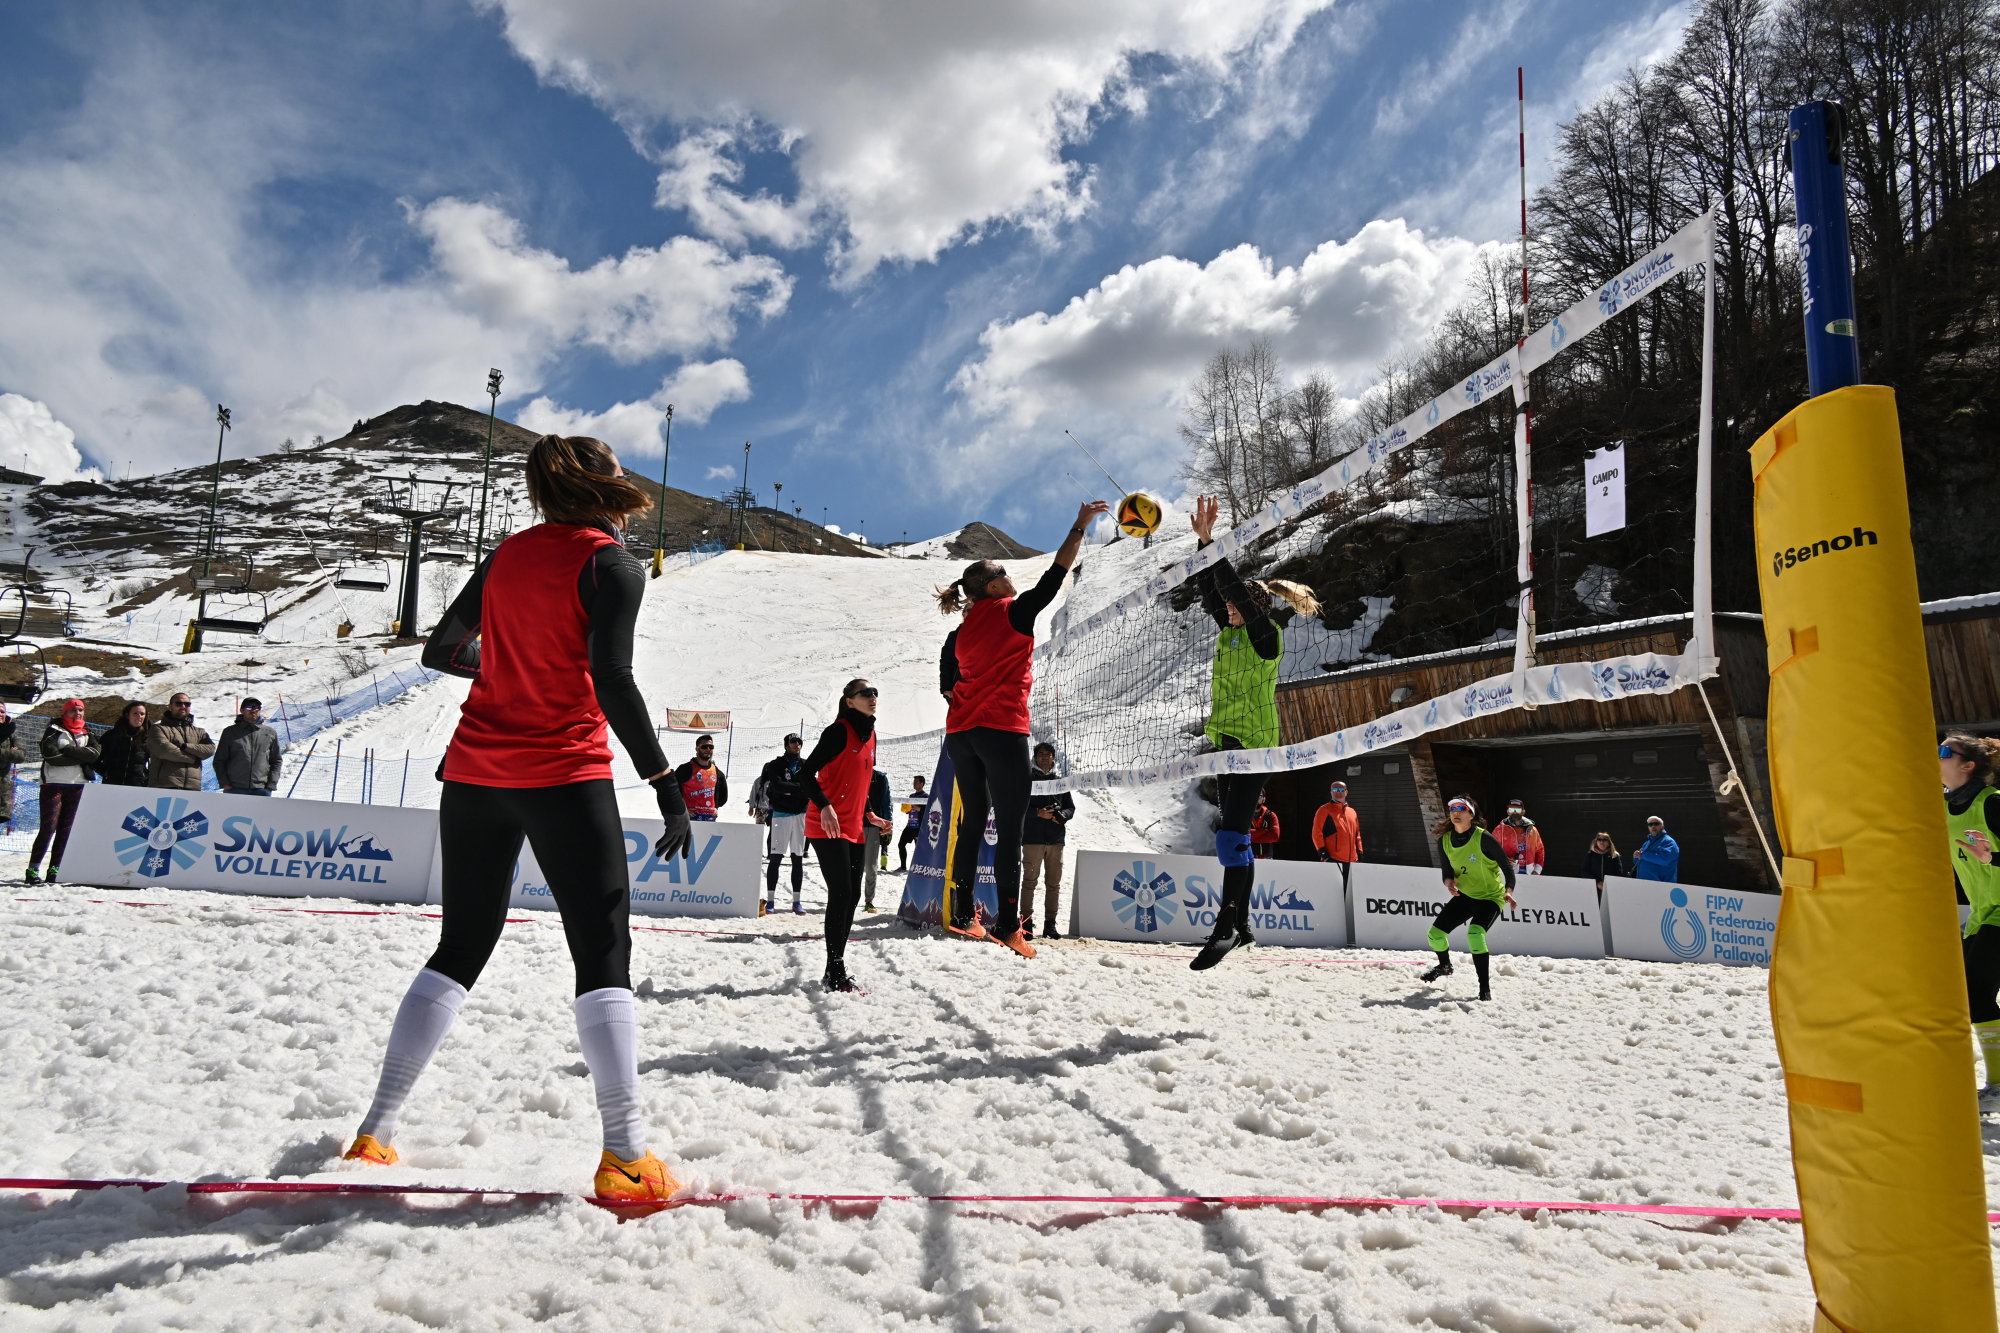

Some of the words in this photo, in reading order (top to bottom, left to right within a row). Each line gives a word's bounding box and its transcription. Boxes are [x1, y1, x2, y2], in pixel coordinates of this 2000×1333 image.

[1622, 253, 1660, 291] SNOW
[1625, 261, 1675, 299] VOLLEYBALL
[1800, 247, 1815, 316] Senoh
[1592, 467, 1619, 486] CAMPO
[1602, 486, 1609, 497] 2
[1784, 526, 1878, 569] Senoh
[213, 815, 349, 858] SNOW
[214, 854, 387, 884] VOLLEYBALL
[622, 830, 723, 885] PAV
[1958, 847, 1968, 862] 4
[1460, 865, 1468, 875] 2
[670, 889, 733, 905] Pallavolo
[1183, 875, 1276, 910] SNW
[1705, 894, 1744, 912] FIPAV
[1186, 910, 1315, 931] VOYBALL
[1366, 897, 1449, 917] DECATHLO
[1500, 908, 1590, 927] LLEYBALL
[1711, 927, 1765, 947] Italiana
